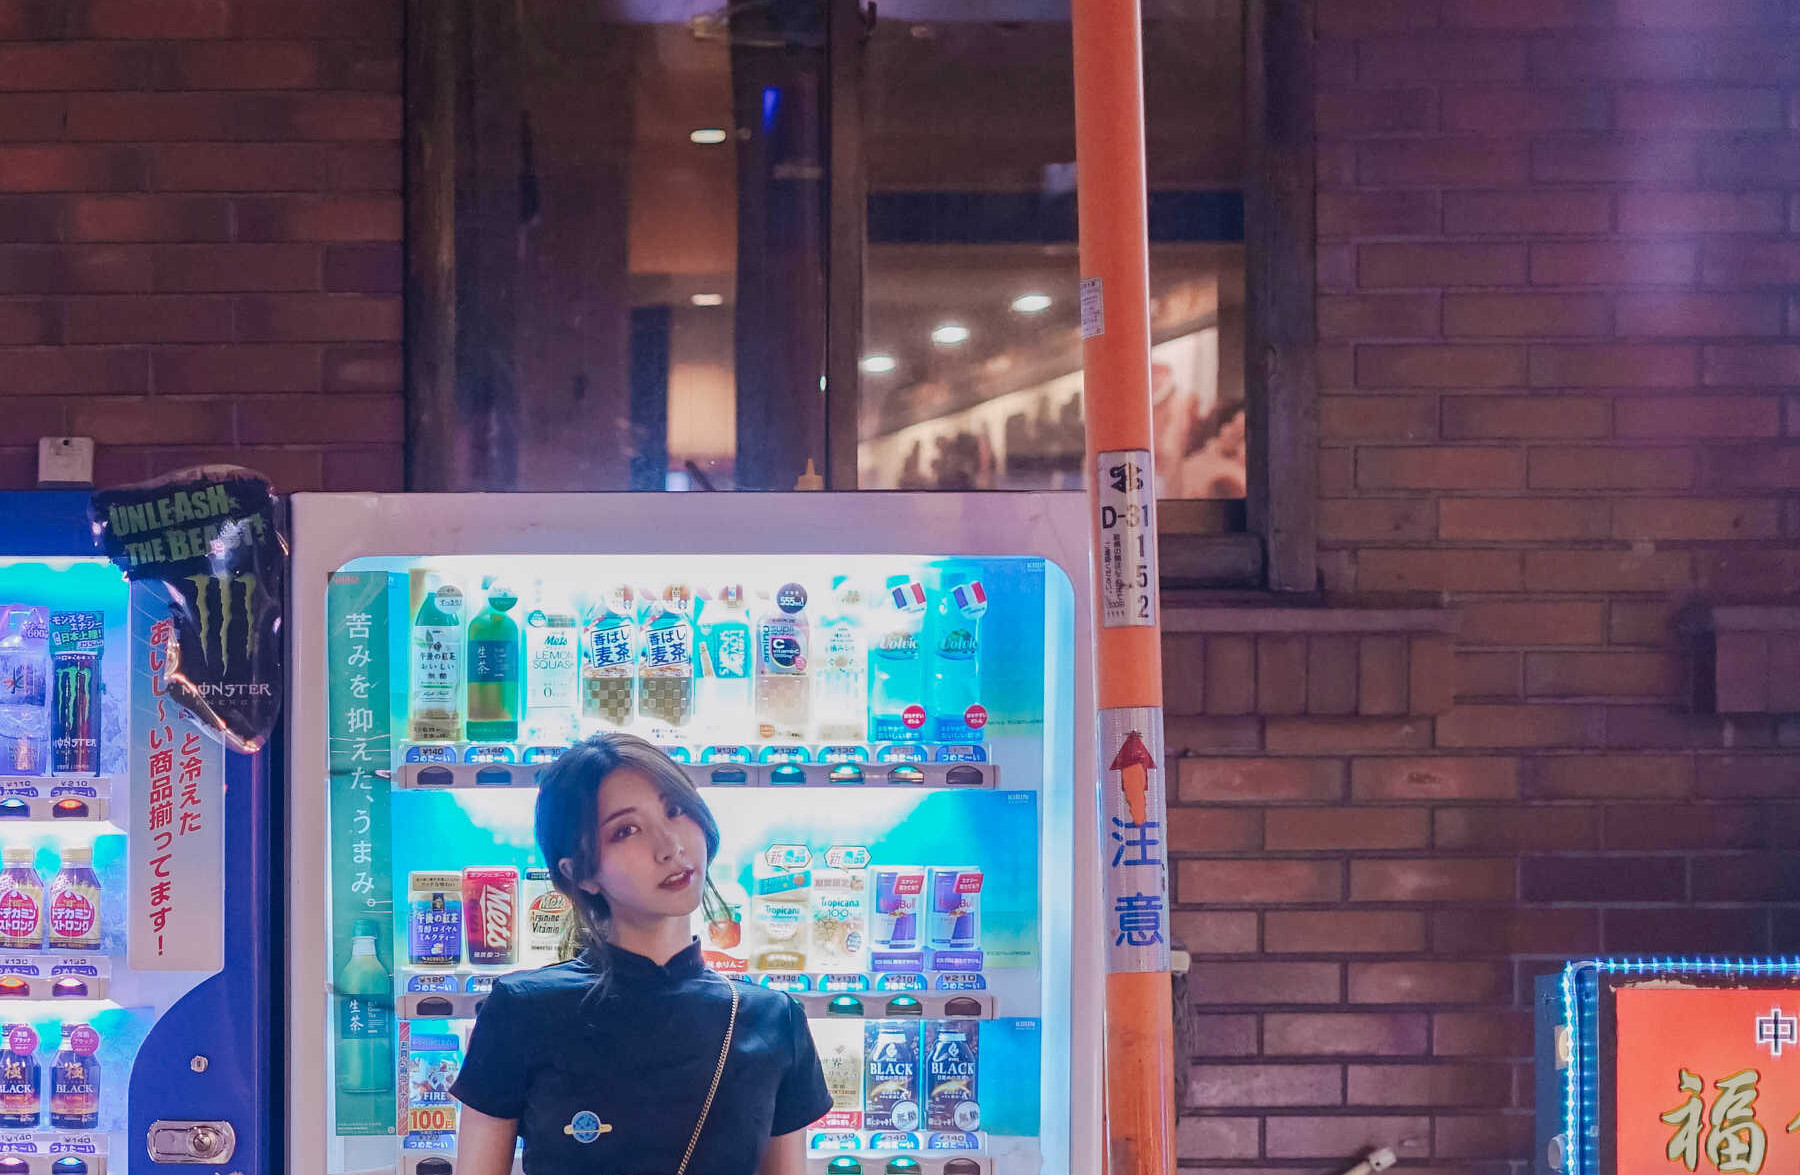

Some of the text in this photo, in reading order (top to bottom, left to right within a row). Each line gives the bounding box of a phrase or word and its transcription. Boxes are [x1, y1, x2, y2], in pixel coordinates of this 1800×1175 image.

[112, 484, 239, 537] UNLEASH
[125, 540, 166, 567] THE
[594, 643, 632, 666] 麦茶
[649, 643, 687, 665] 麦茶
[181, 681, 272, 697] MONSTER
[1111, 816, 1165, 947] 注意
[870, 1062, 913, 1076] BLACK
[932, 1062, 975, 1076] BLACK
[56, 1084, 93, 1094] BLACK
[423, 1091, 447, 1101] FIRE
